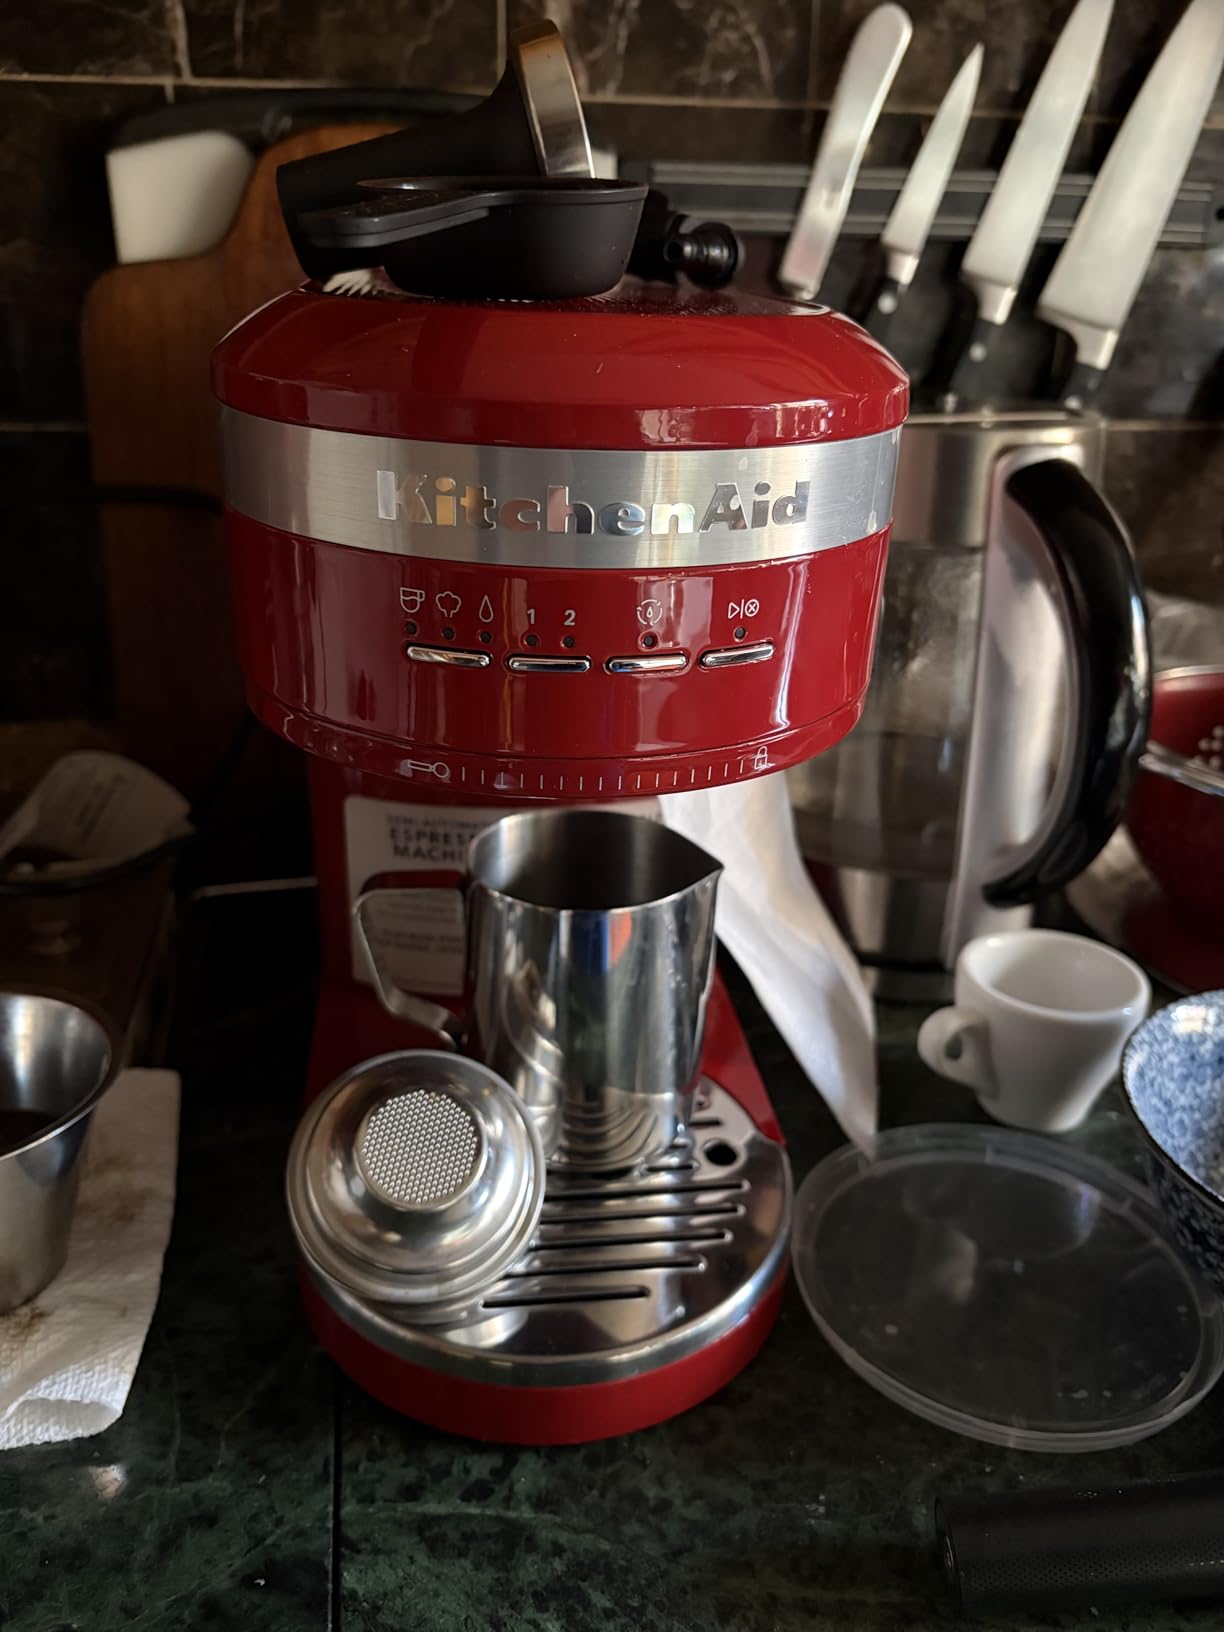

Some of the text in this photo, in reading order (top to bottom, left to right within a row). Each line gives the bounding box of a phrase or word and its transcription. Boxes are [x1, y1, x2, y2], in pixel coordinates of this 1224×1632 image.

[377, 470, 811, 536] KitchenAid
[527, 609, 576, 626] 1 2
